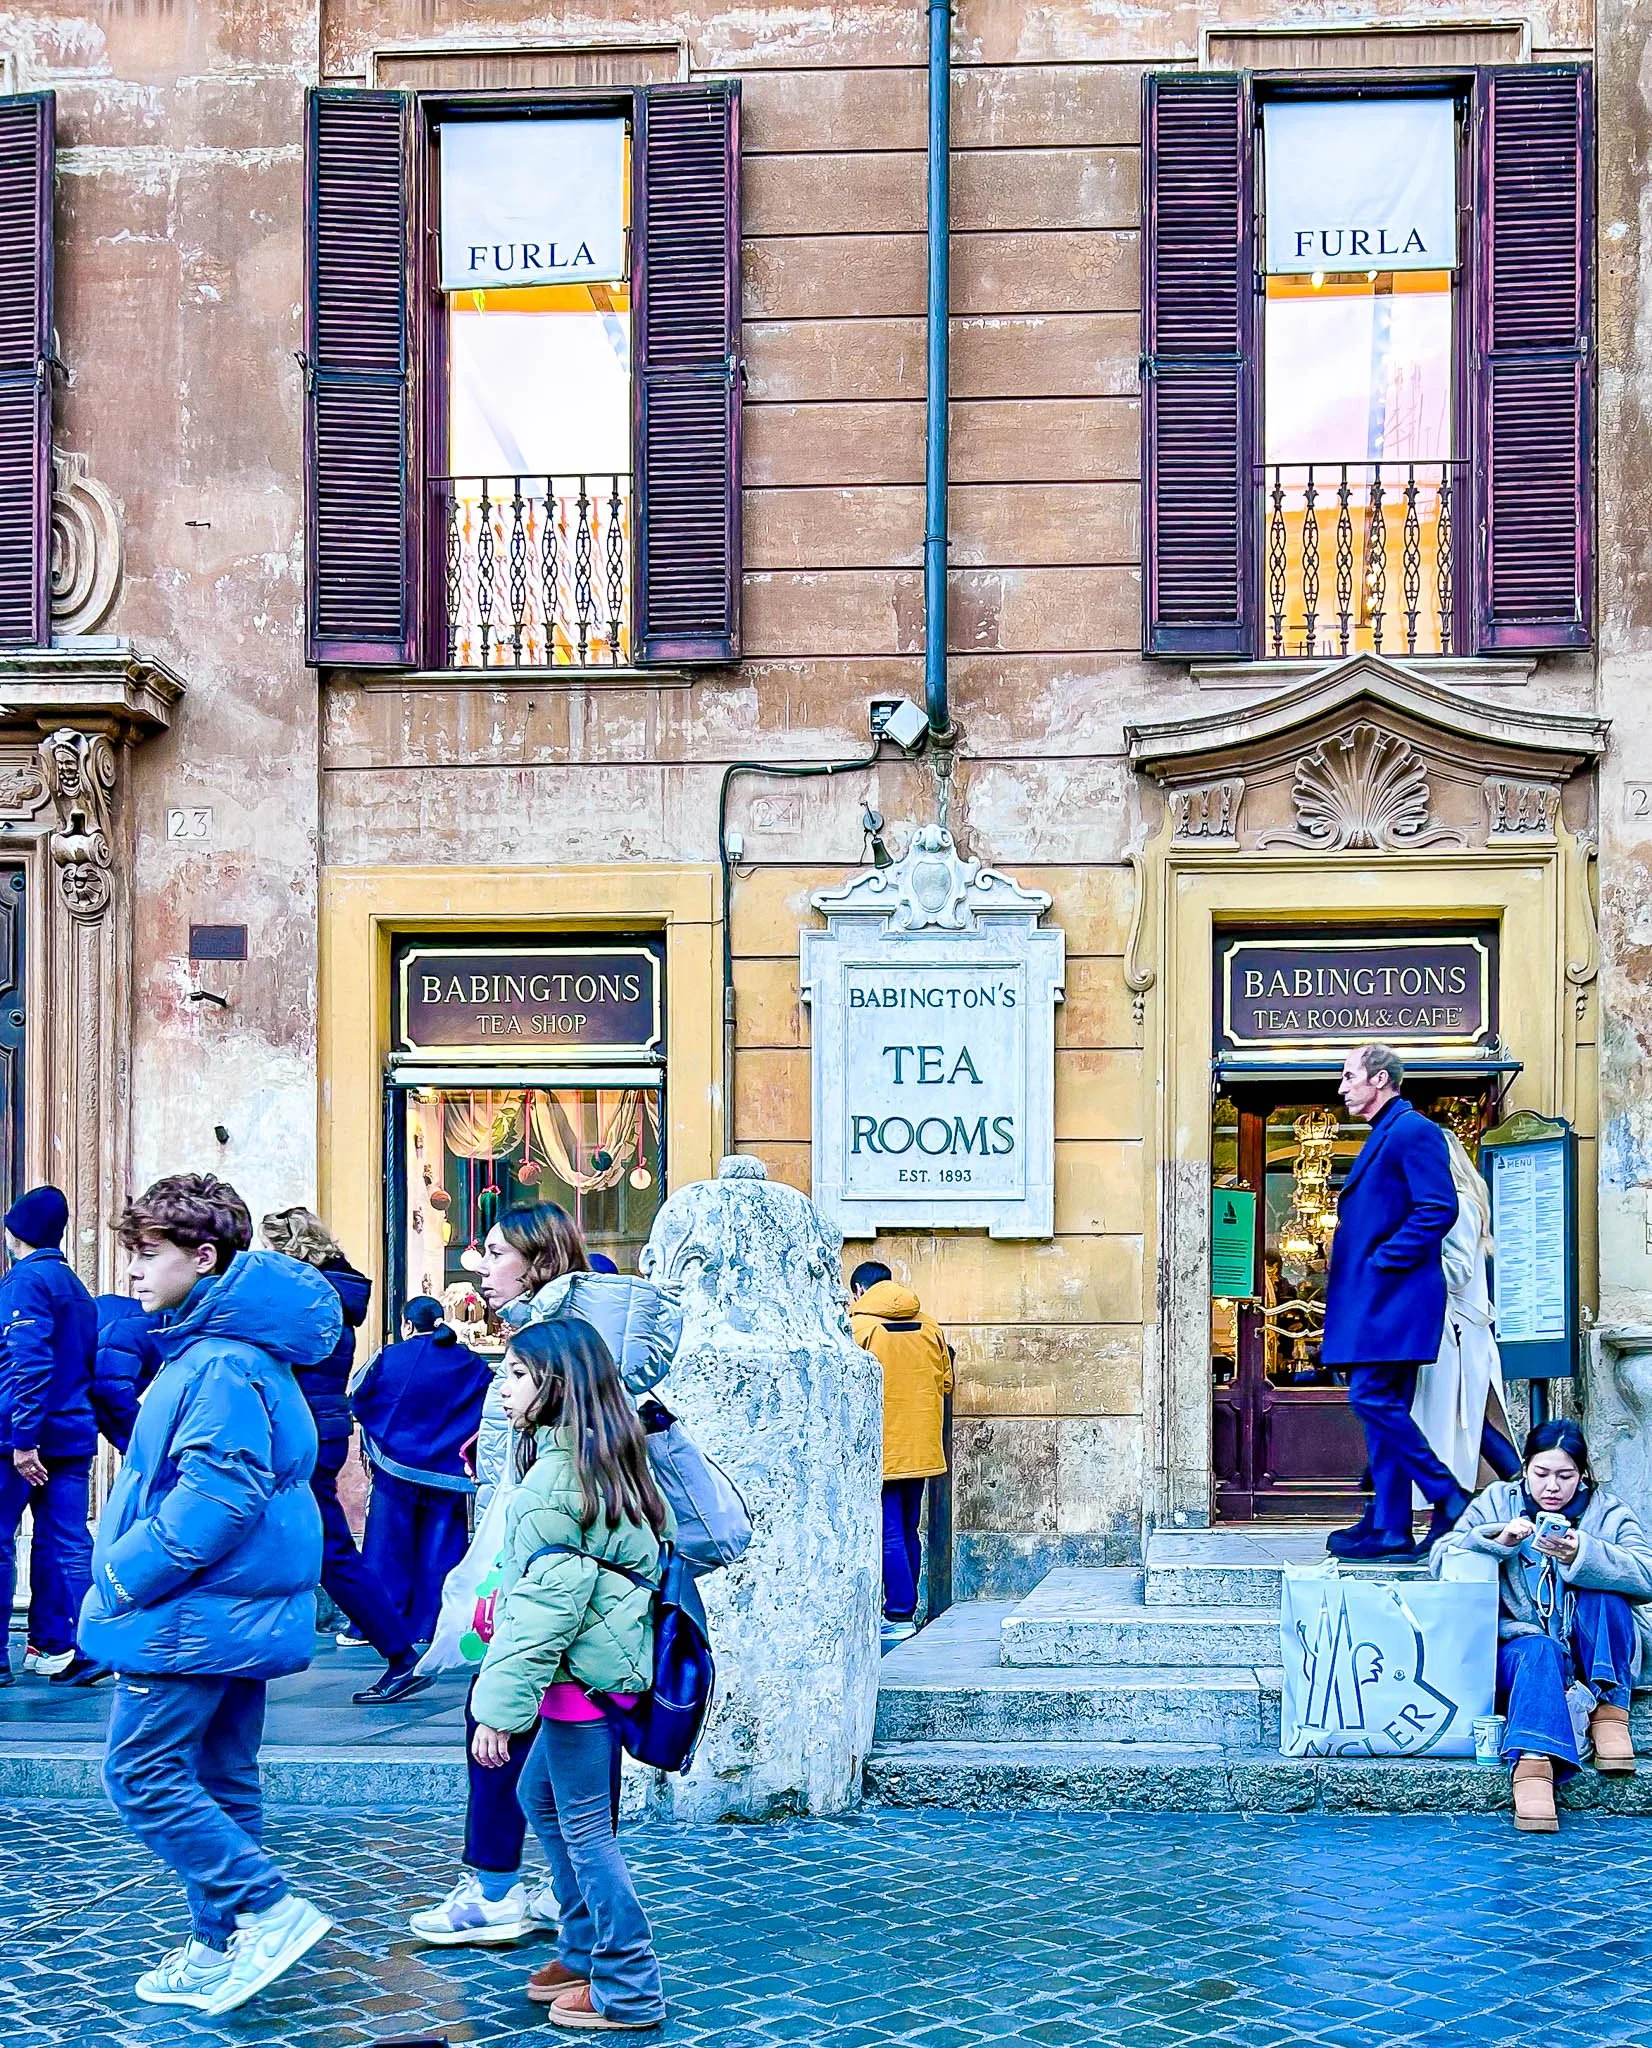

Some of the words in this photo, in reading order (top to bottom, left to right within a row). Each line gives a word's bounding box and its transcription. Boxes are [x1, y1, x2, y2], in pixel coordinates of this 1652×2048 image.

[467, 241, 596, 271] FURLA
[1294, 227, 1428, 257] FURLA
[171, 811, 208, 837] 23
[421, 974, 641, 1004] BABINGTONS
[849, 982, 1017, 1009] BABINGTON'S
[1244, 966, 1467, 999] BABINGTONS
[476, 1014, 523, 1034] TEA
[531, 1013, 588, 1034] SHOP
[1252, 1009, 1300, 1030] TEA
[1307, 1008, 1369, 1030] ROOM
[1376, 1008, 1392, 1027] &
[882, 1045, 984, 1084] TEA
[850, 1115, 1015, 1156] ROOMS
[898, 1169, 931, 1182] EST.
[938, 1169, 972, 1182] 1893
[1507, 1158, 1532, 1169] MENU
